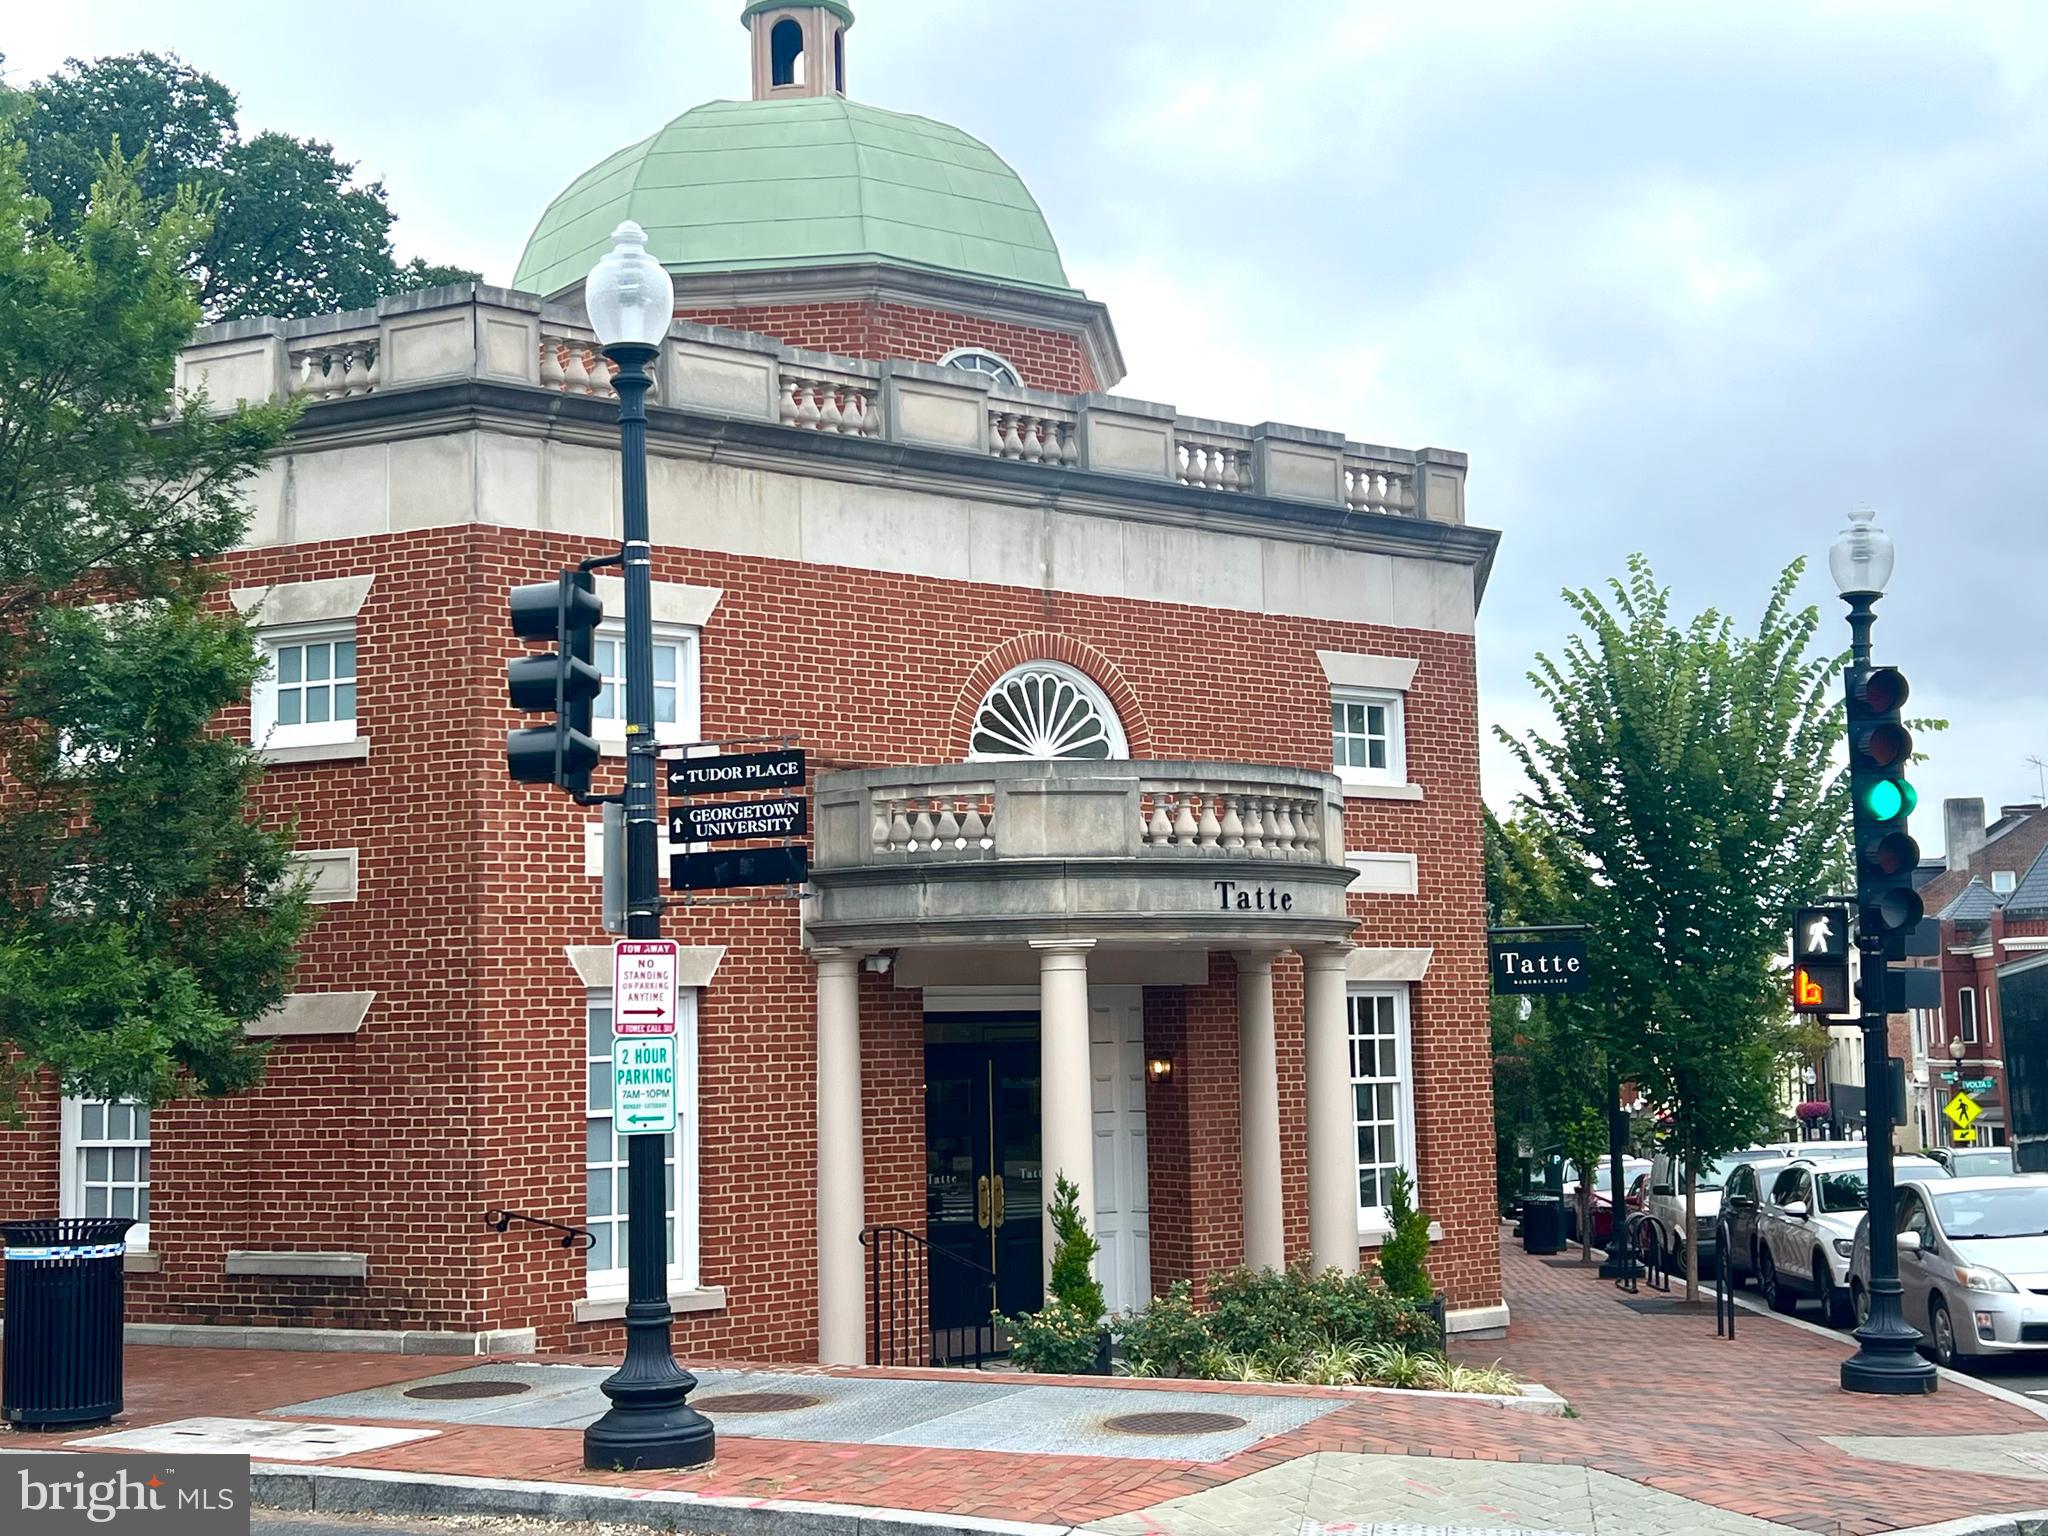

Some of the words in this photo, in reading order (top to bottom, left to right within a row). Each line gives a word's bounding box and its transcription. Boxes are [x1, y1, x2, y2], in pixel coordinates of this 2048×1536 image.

[687, 765, 742, 783] TUDOR
[746, 762, 799, 778] PLACE
[689, 802, 799, 822] GEORGETOWN
[696, 817, 794, 837] UNIVERSITY
[1214, 881, 1292, 911] Tatte
[622, 945, 641, 953] TOW
[644, 944, 670, 953] AWAY
[638, 959, 654, 968] NO
[1500, 952, 1580, 974] Tatte
[624, 971, 669, 980] STANDING
[622, 982, 633, 990] OR
[634, 982, 669, 990] PARKING
[628, 992, 664, 1002] ANYTIME
[622, 1049, 629, 1065] 2
[635, 1048, 667, 1064] HOUR
[617, 1068, 672, 1085] PARKING
[1965, 1080, 1986, 1089] VOLTA
[1018, 1168, 1042, 1180] Tatt
